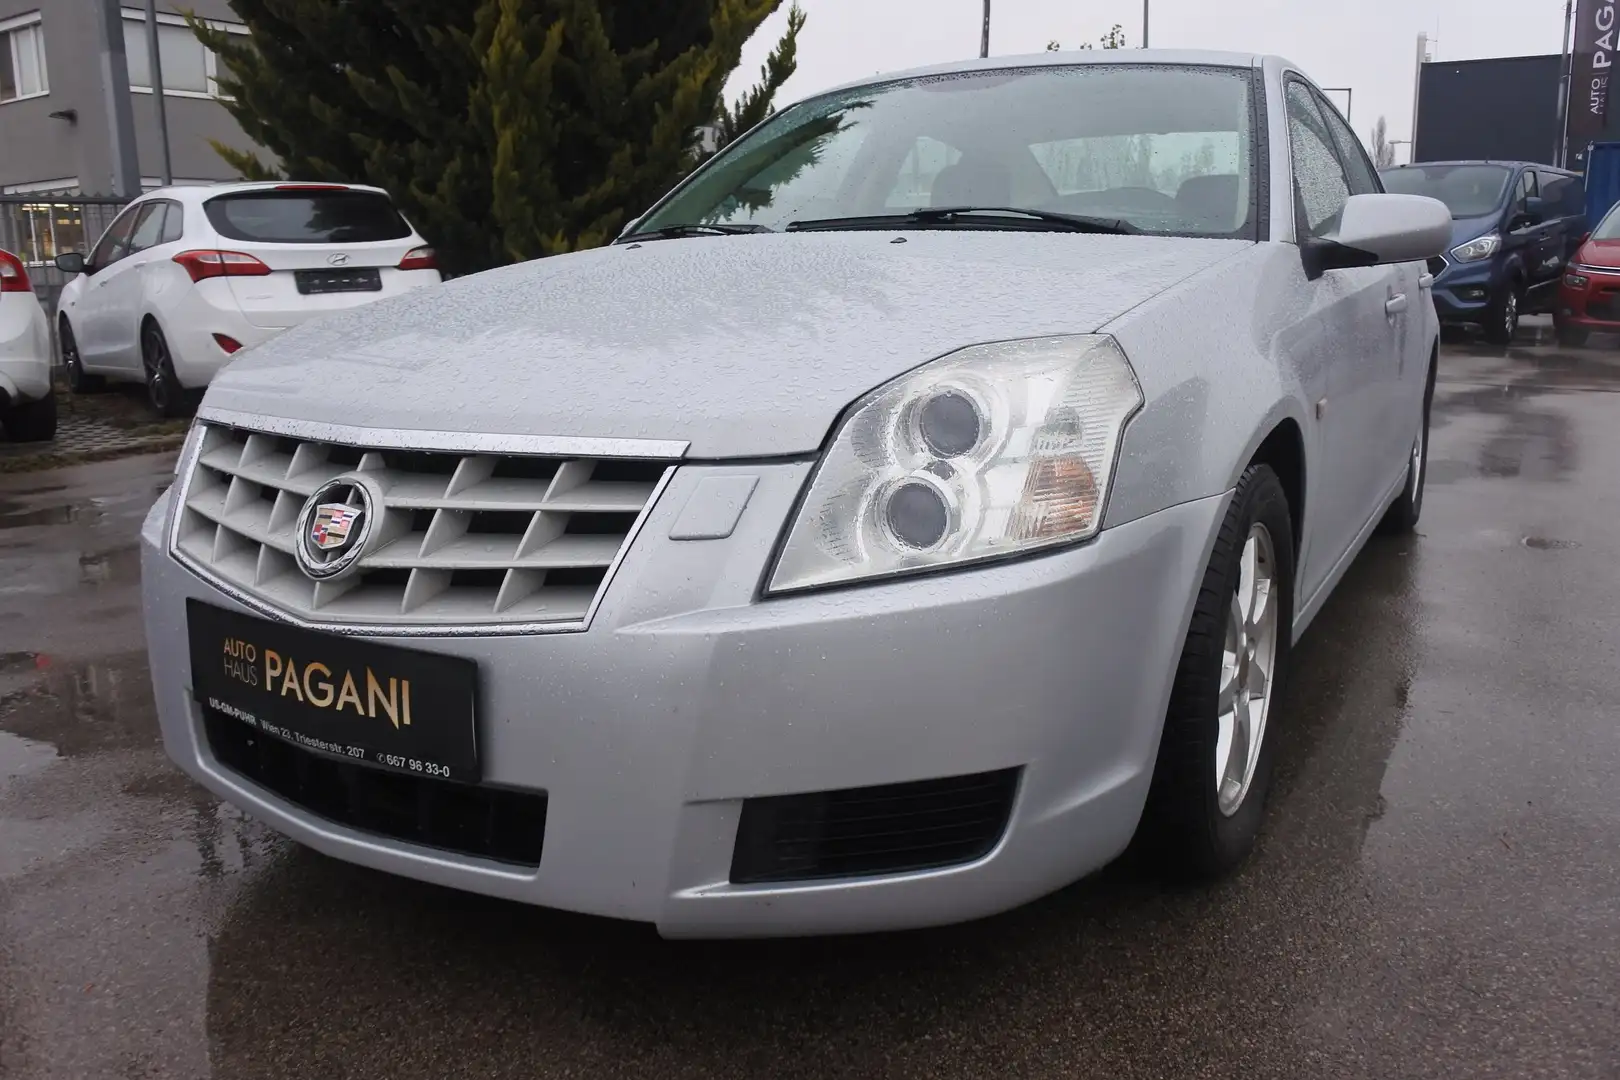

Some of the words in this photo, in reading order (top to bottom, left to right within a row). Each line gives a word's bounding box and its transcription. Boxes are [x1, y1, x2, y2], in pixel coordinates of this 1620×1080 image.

[1592, 0, 1615, 69] PAG
[1590, 78, 1600, 115] AUTO
[223, 637, 256, 662] AUTO
[223, 657, 258, 686] HAUS
[264, 649, 411, 730] PAGANI
[260, 719, 281, 735] Wien
[294, 732, 346, 754] Triesterstr.
[346, 745, 365, 759] 207
[386, 754, 406, 768] 667
[408, 758, 423, 772] 96
[425, 762, 451, 778] 33-0
